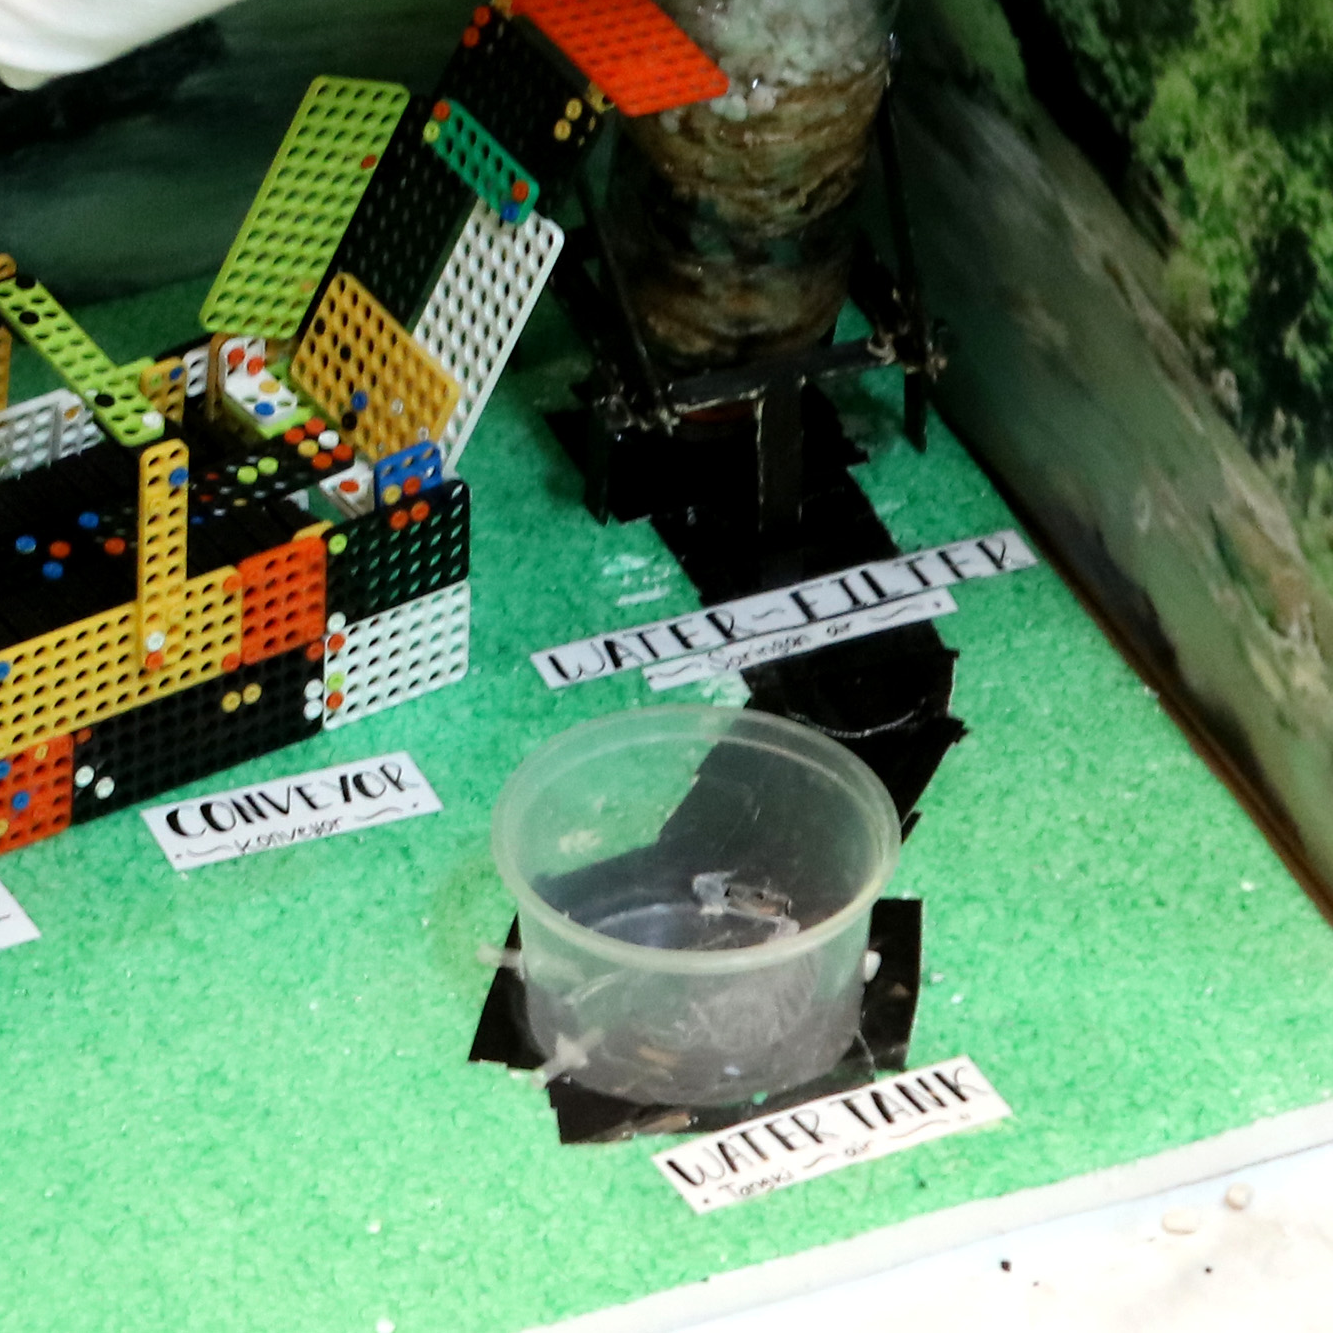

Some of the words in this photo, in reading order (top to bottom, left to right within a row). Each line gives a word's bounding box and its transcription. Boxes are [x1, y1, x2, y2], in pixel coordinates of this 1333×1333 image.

[547, 609, 758, 683] WATER
[165, 762, 420, 839] CONVEYOR
[666, 1108, 839, 1187] WATER
[829, 1066, 988, 1130] TANK
[844, 1138, 875, 1159] air
